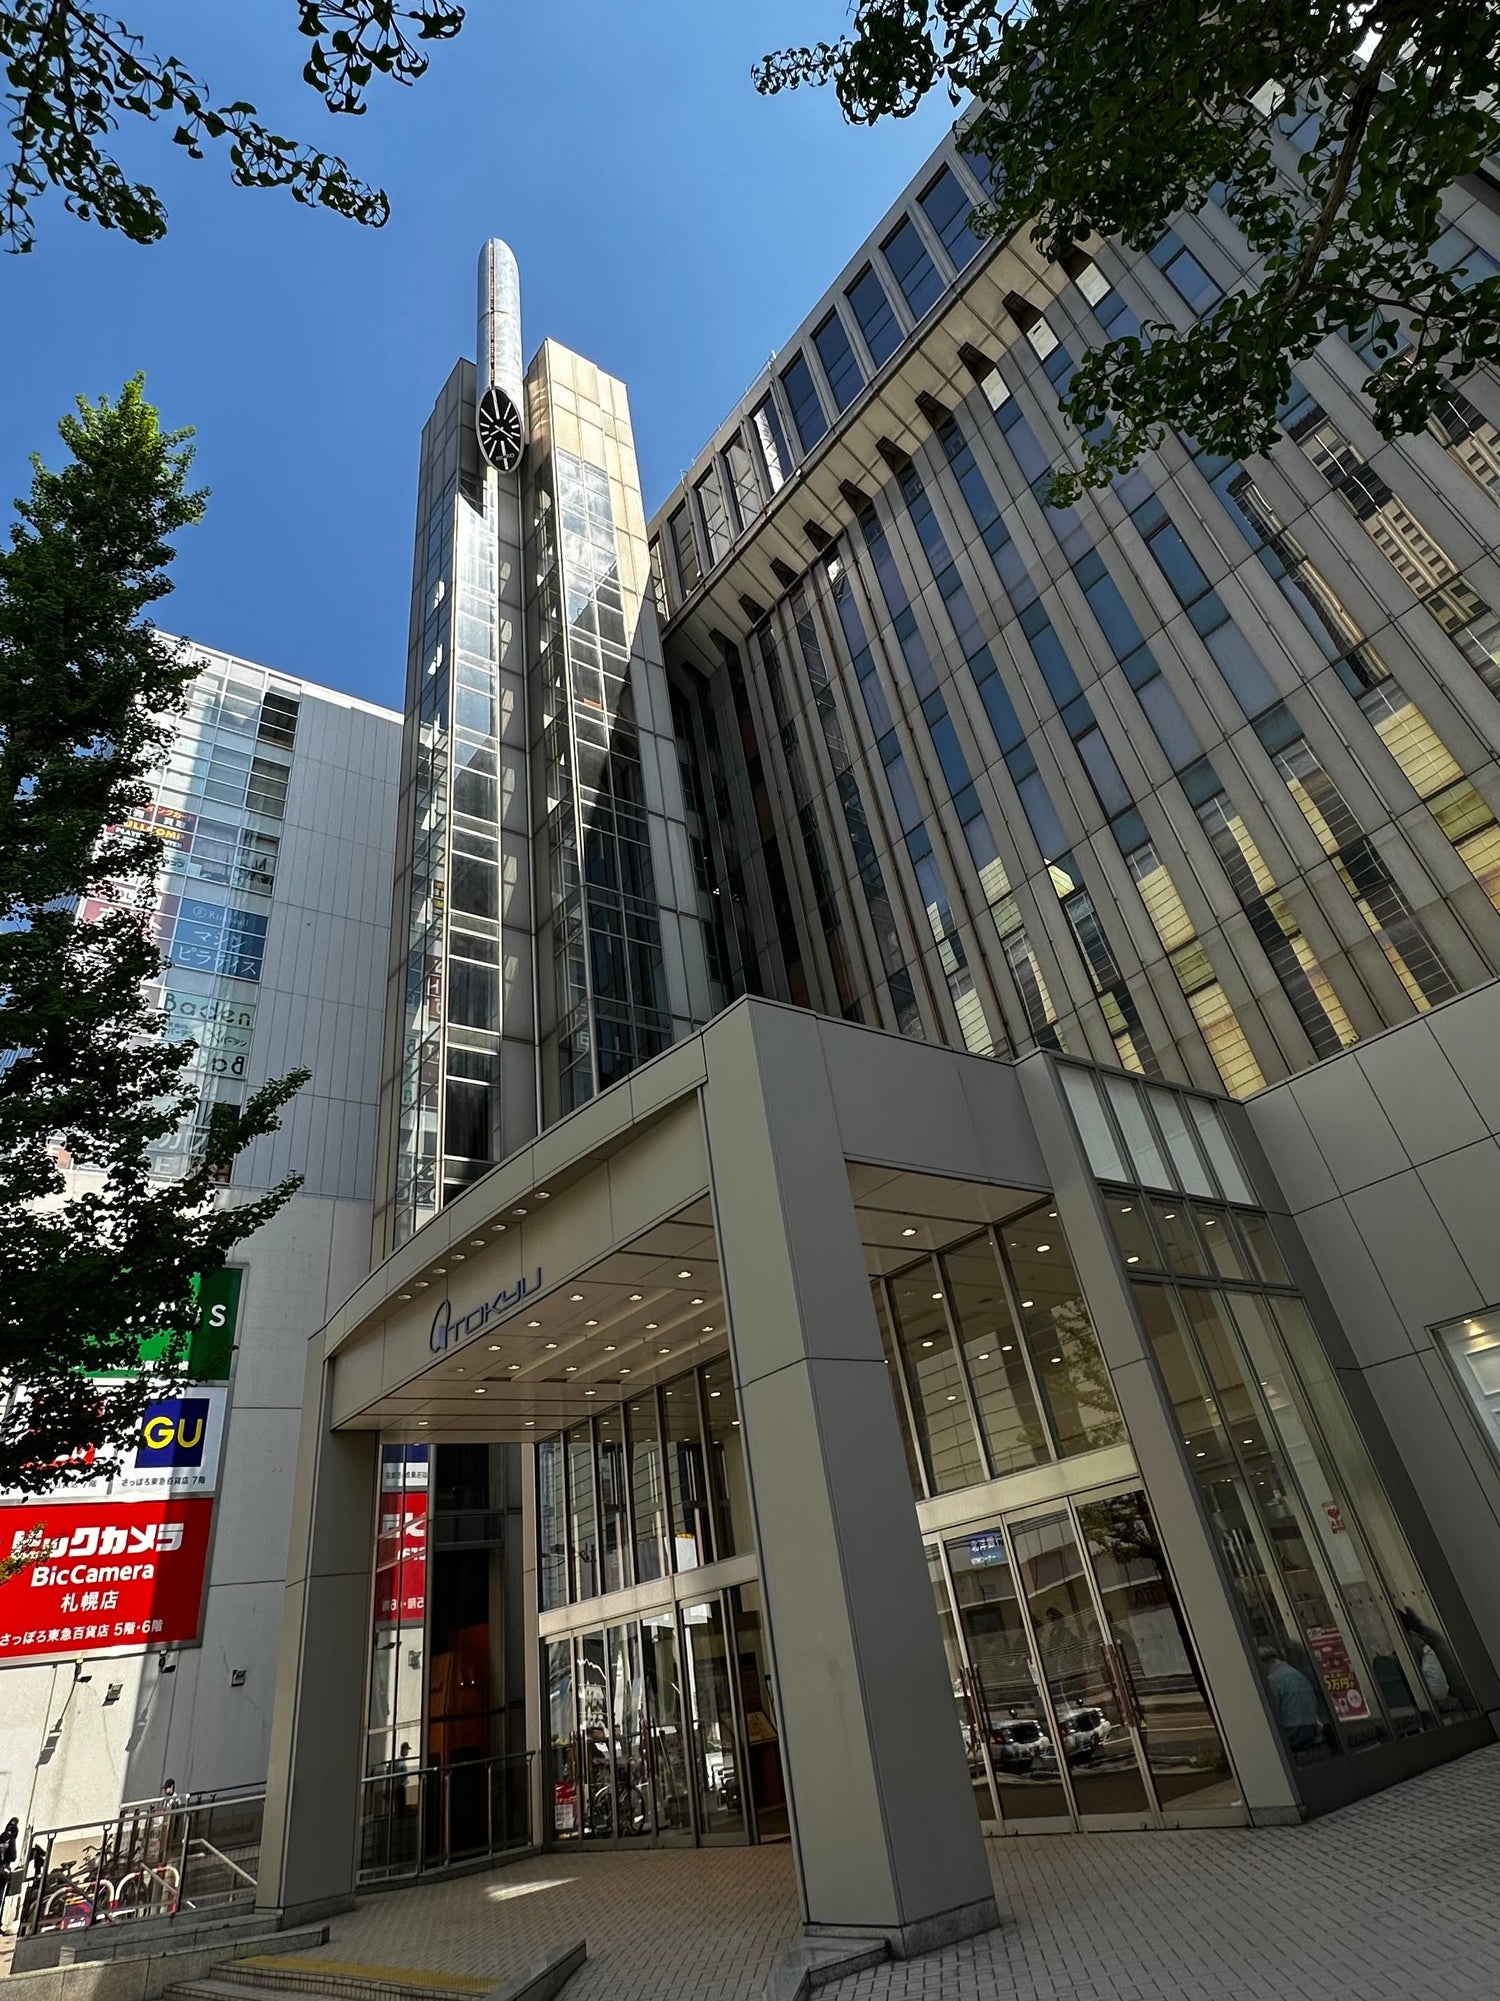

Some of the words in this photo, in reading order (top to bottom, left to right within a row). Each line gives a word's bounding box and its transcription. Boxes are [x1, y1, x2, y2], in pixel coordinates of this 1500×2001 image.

[193, 930, 247, 948] マシン
[178, 945, 257, 976] ピラティス
[163, 992, 251, 1027] Baden
[447, 1266, 542, 1343] TOKYU
[143, 1416, 204, 1450] GU
[121, 1476, 189, 1487] さっぽろ東急百貨店
[191, 1475, 206, 1485] 7階
[30, 1563, 155, 1588] BicCamera
[60, 1589, 120, 1614] 札幌店
[0, 1624, 110, 1647] さっぽろ東急百貨店
